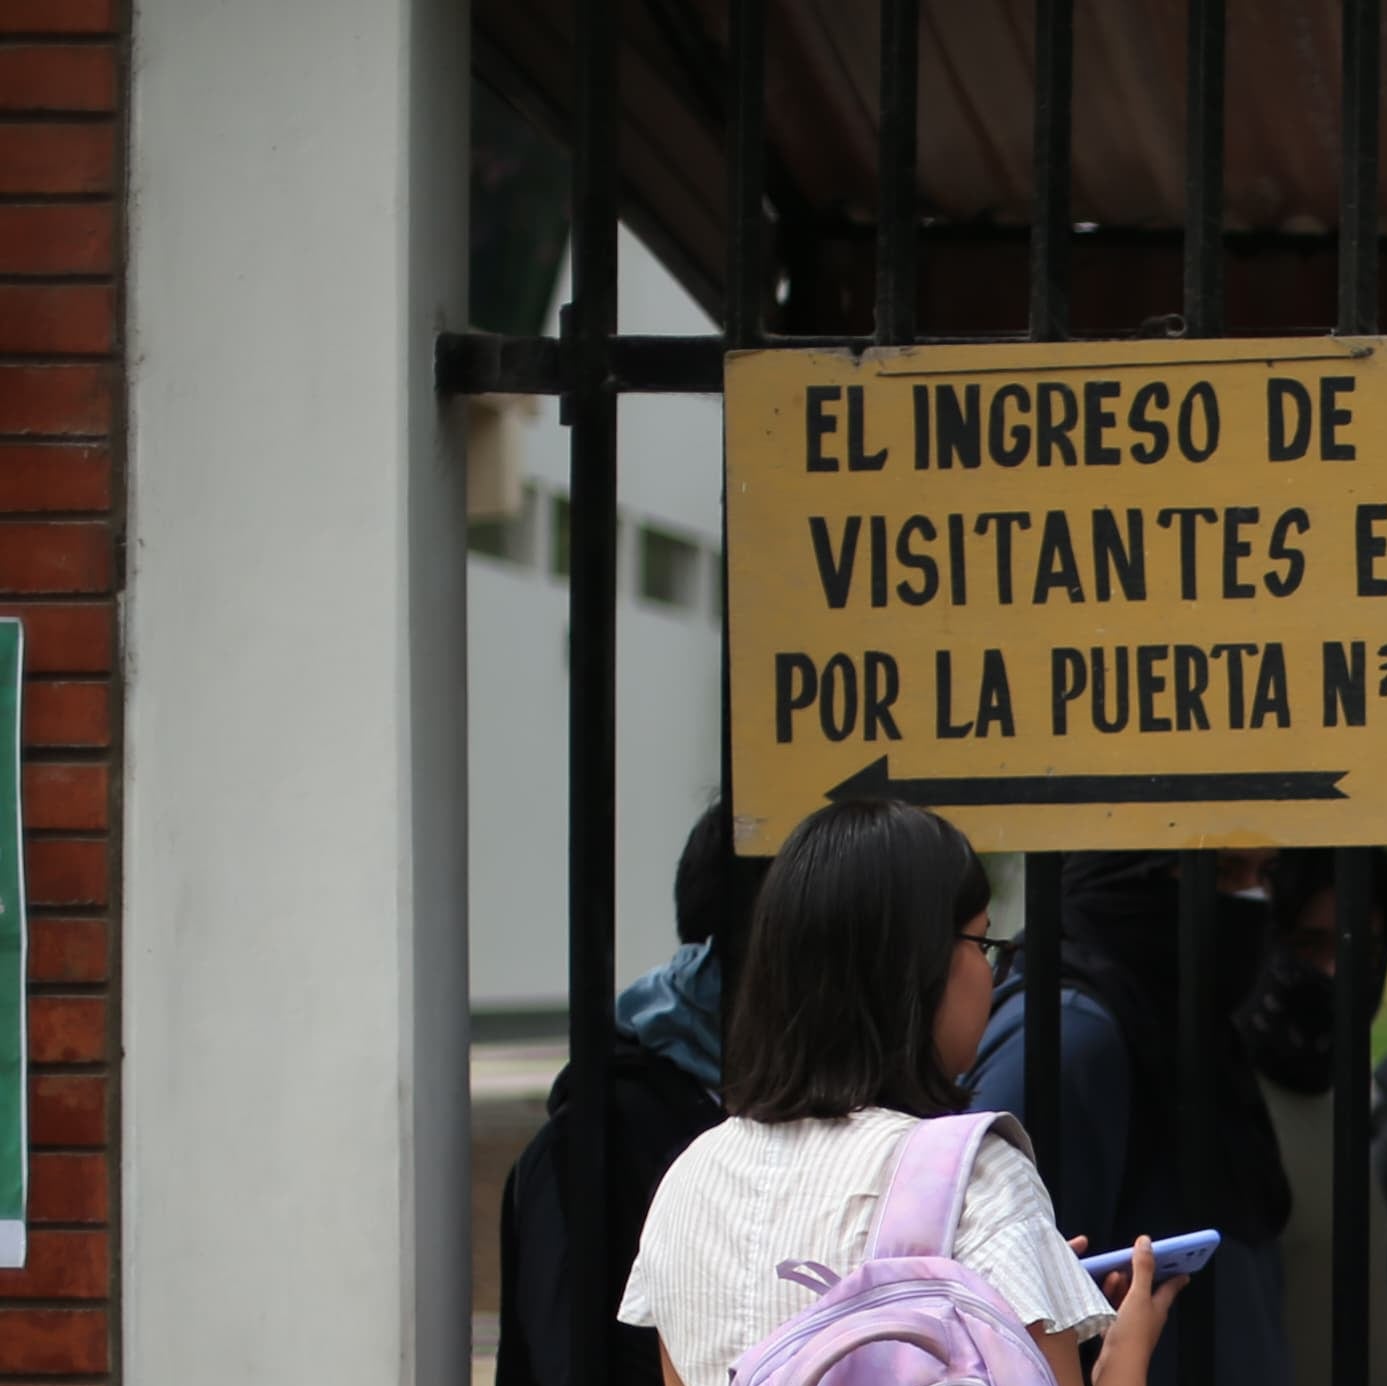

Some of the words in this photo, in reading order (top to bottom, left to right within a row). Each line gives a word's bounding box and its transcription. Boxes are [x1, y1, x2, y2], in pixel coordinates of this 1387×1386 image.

[805, 384, 888, 473] EL
[912, 379, 1221, 471] INGRESO
[1267, 376, 1357, 463] DE
[809, 506, 1311, 609] VISITANTES
[774, 651, 903, 744] POR
[935, 648, 1016, 738] LA
[1051, 641, 1292, 736] PUERTA
